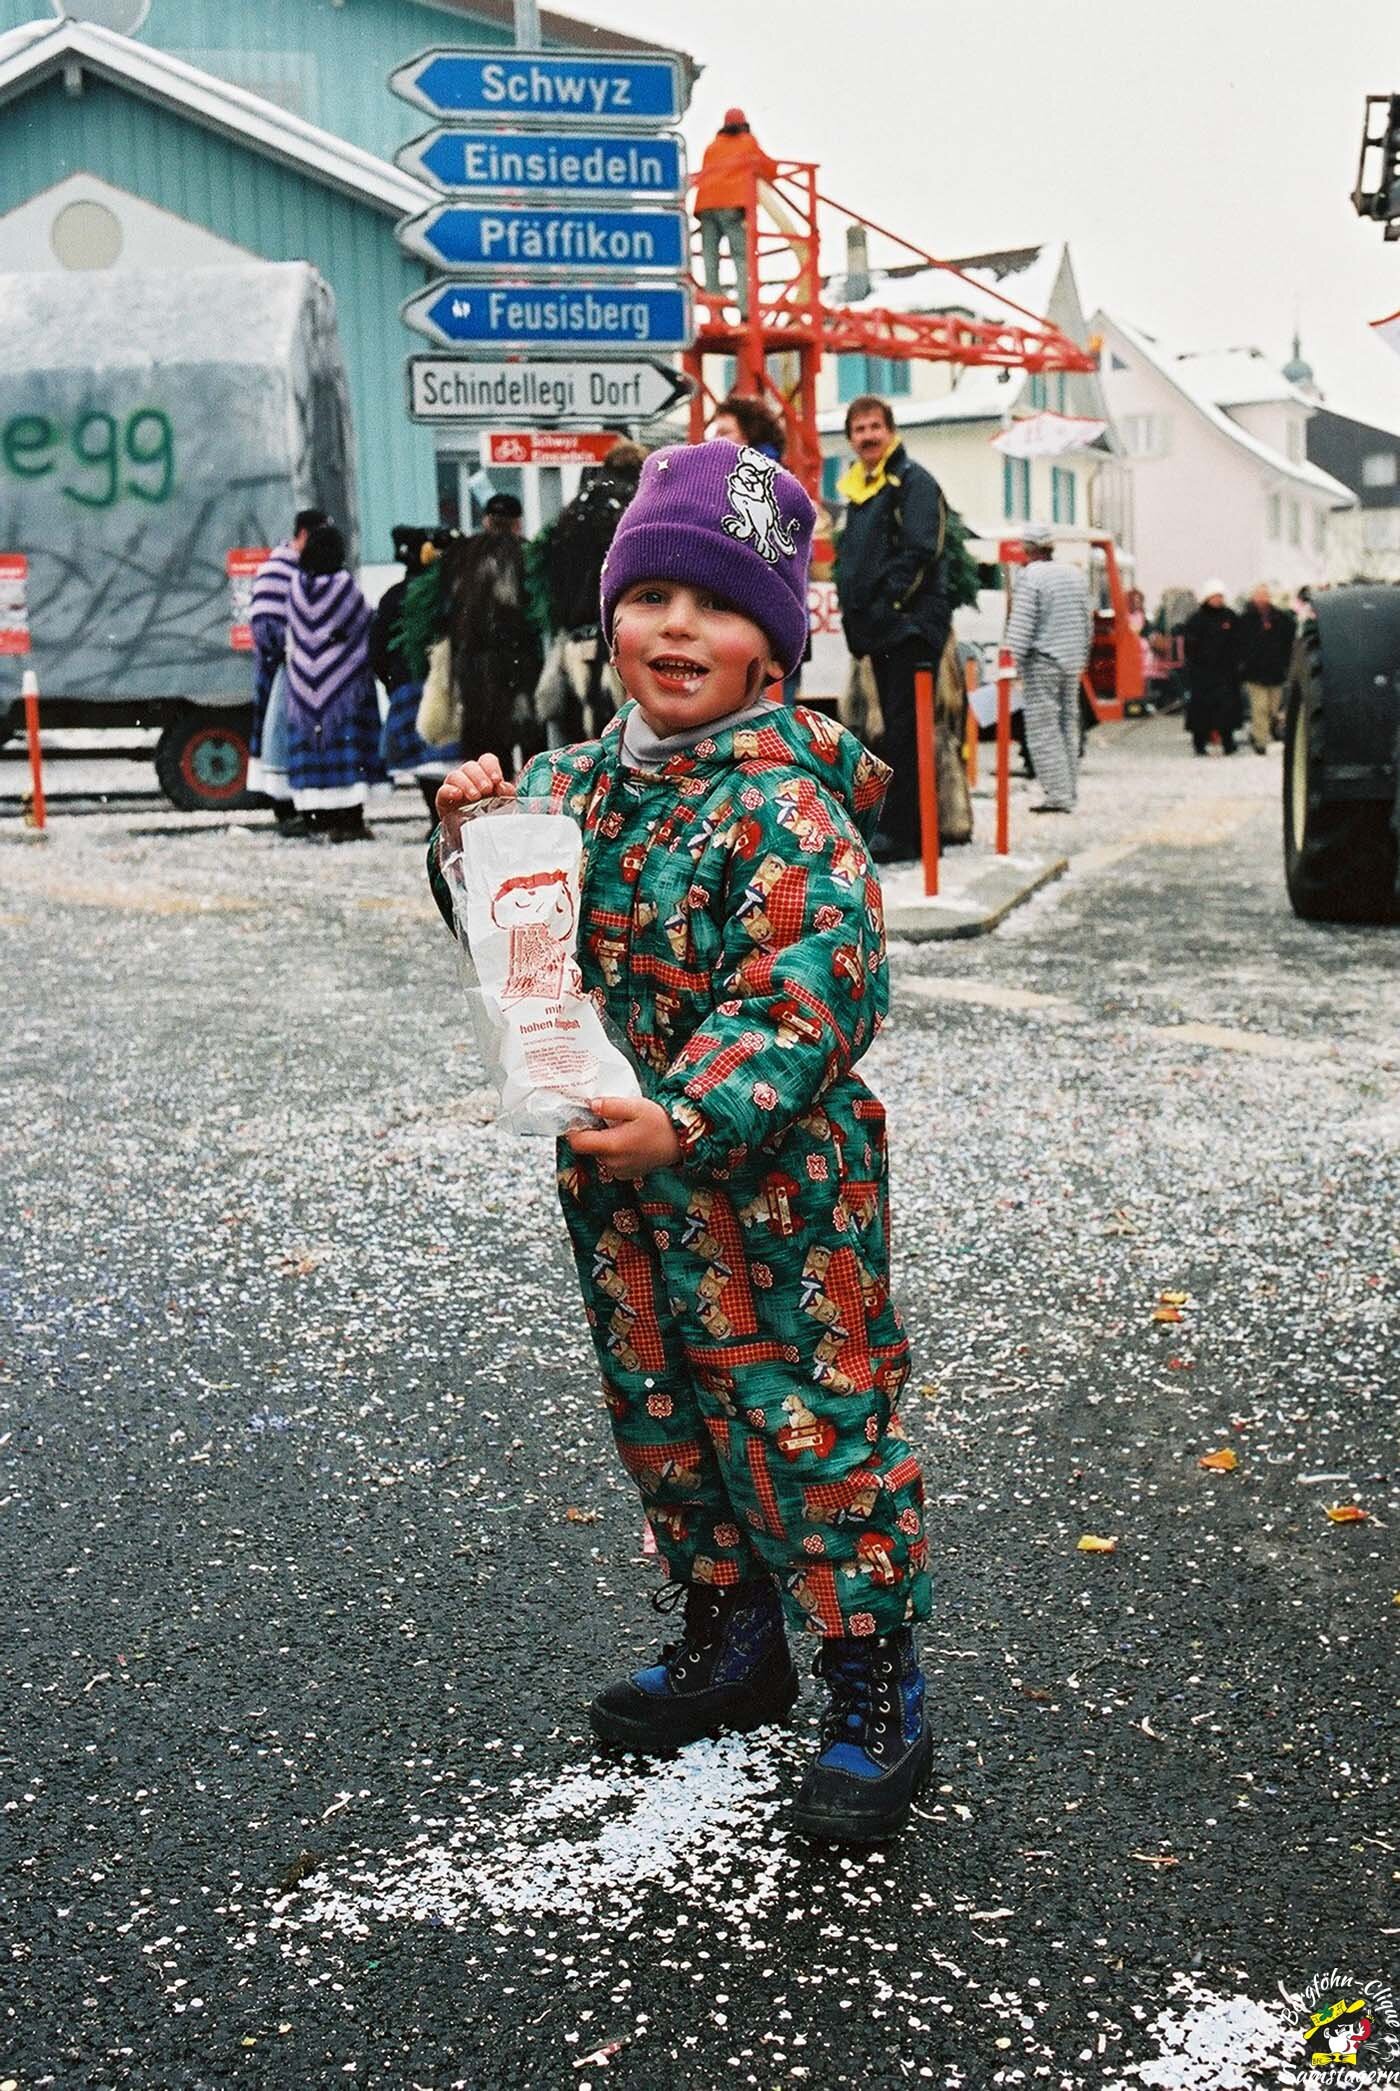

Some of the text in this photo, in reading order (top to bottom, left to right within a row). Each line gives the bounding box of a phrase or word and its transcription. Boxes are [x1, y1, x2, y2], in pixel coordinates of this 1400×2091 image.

[481, 64, 632, 112] Schwyz
[464, 143, 663, 185] Einsiedeln
[480, 217, 654, 258] Pfäffikon
[488, 292, 650, 340] Feusisberg
[423, 371, 641, 411] Schindellegi Dorf
